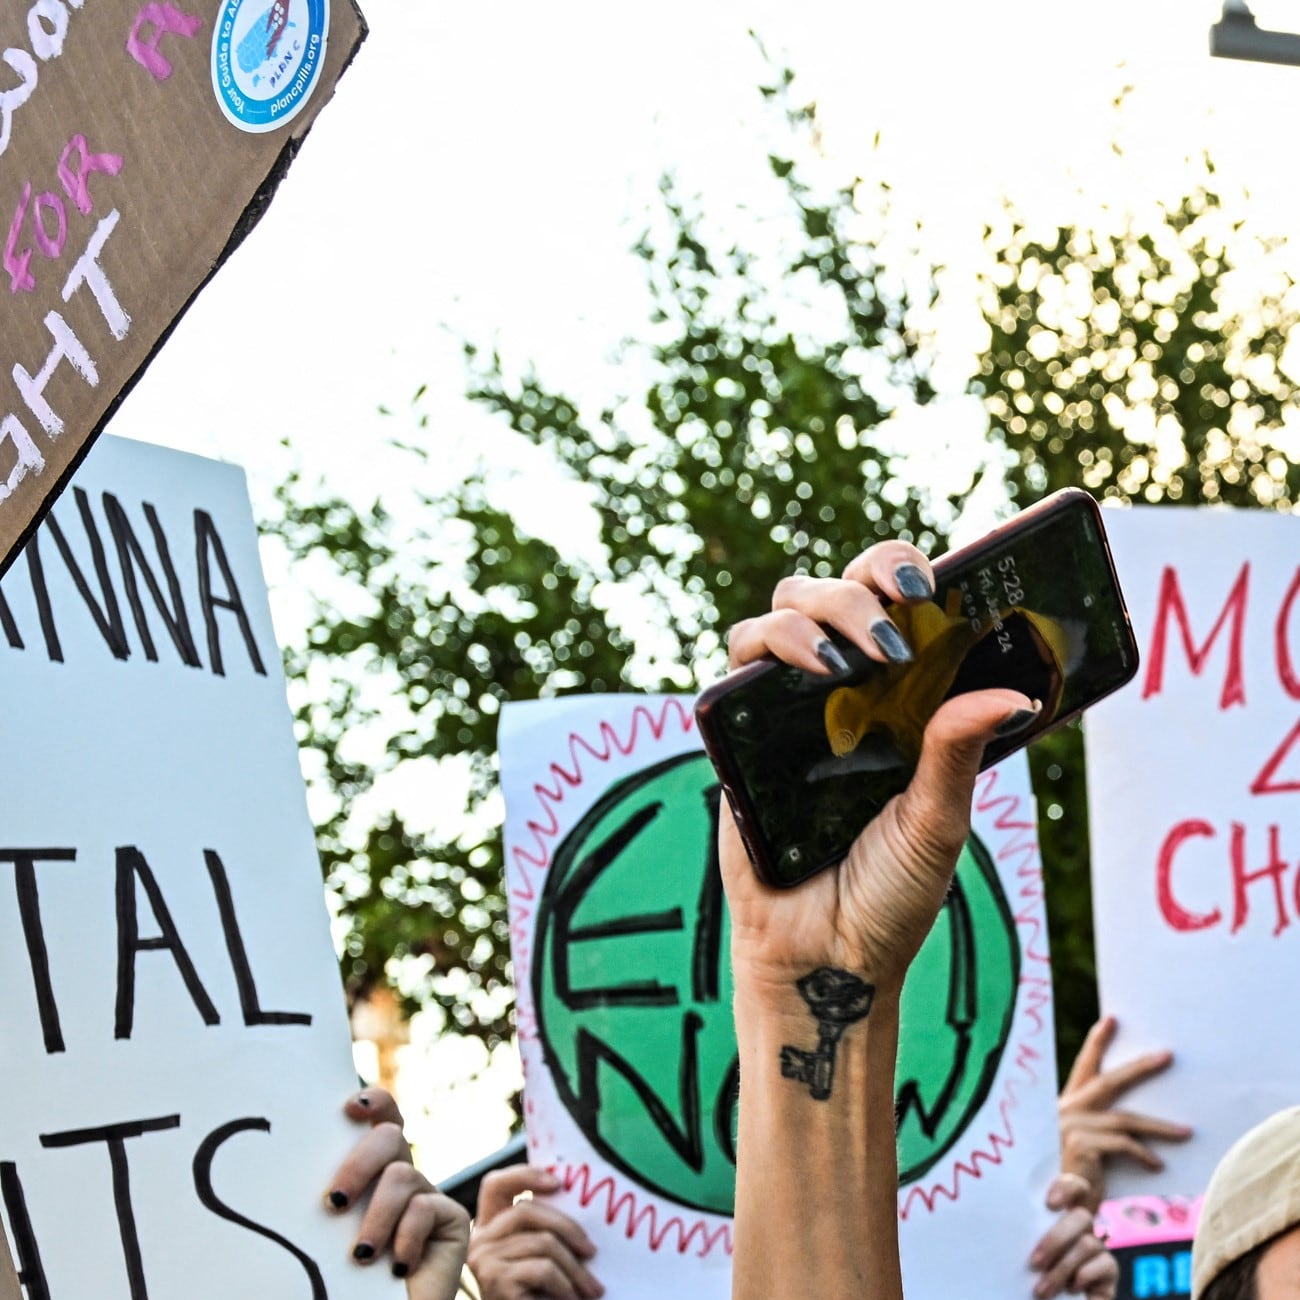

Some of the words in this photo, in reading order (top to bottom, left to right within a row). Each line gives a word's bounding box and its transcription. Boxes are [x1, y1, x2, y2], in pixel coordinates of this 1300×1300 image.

[221, 20, 232, 38] to
[219, 42, 231, 88] Guide
[269, 51, 293, 89] PLAN
[270, 34, 320, 117] plancpills.org
[227, 87, 245, 114] Your
[3, 133, 125, 293] FOR
[0, 485, 268, 678] NNA
[998, 555, 1024, 606] 5:28
[997, 631, 1013, 654] 24
[575, 1009, 971, 1175] NW
